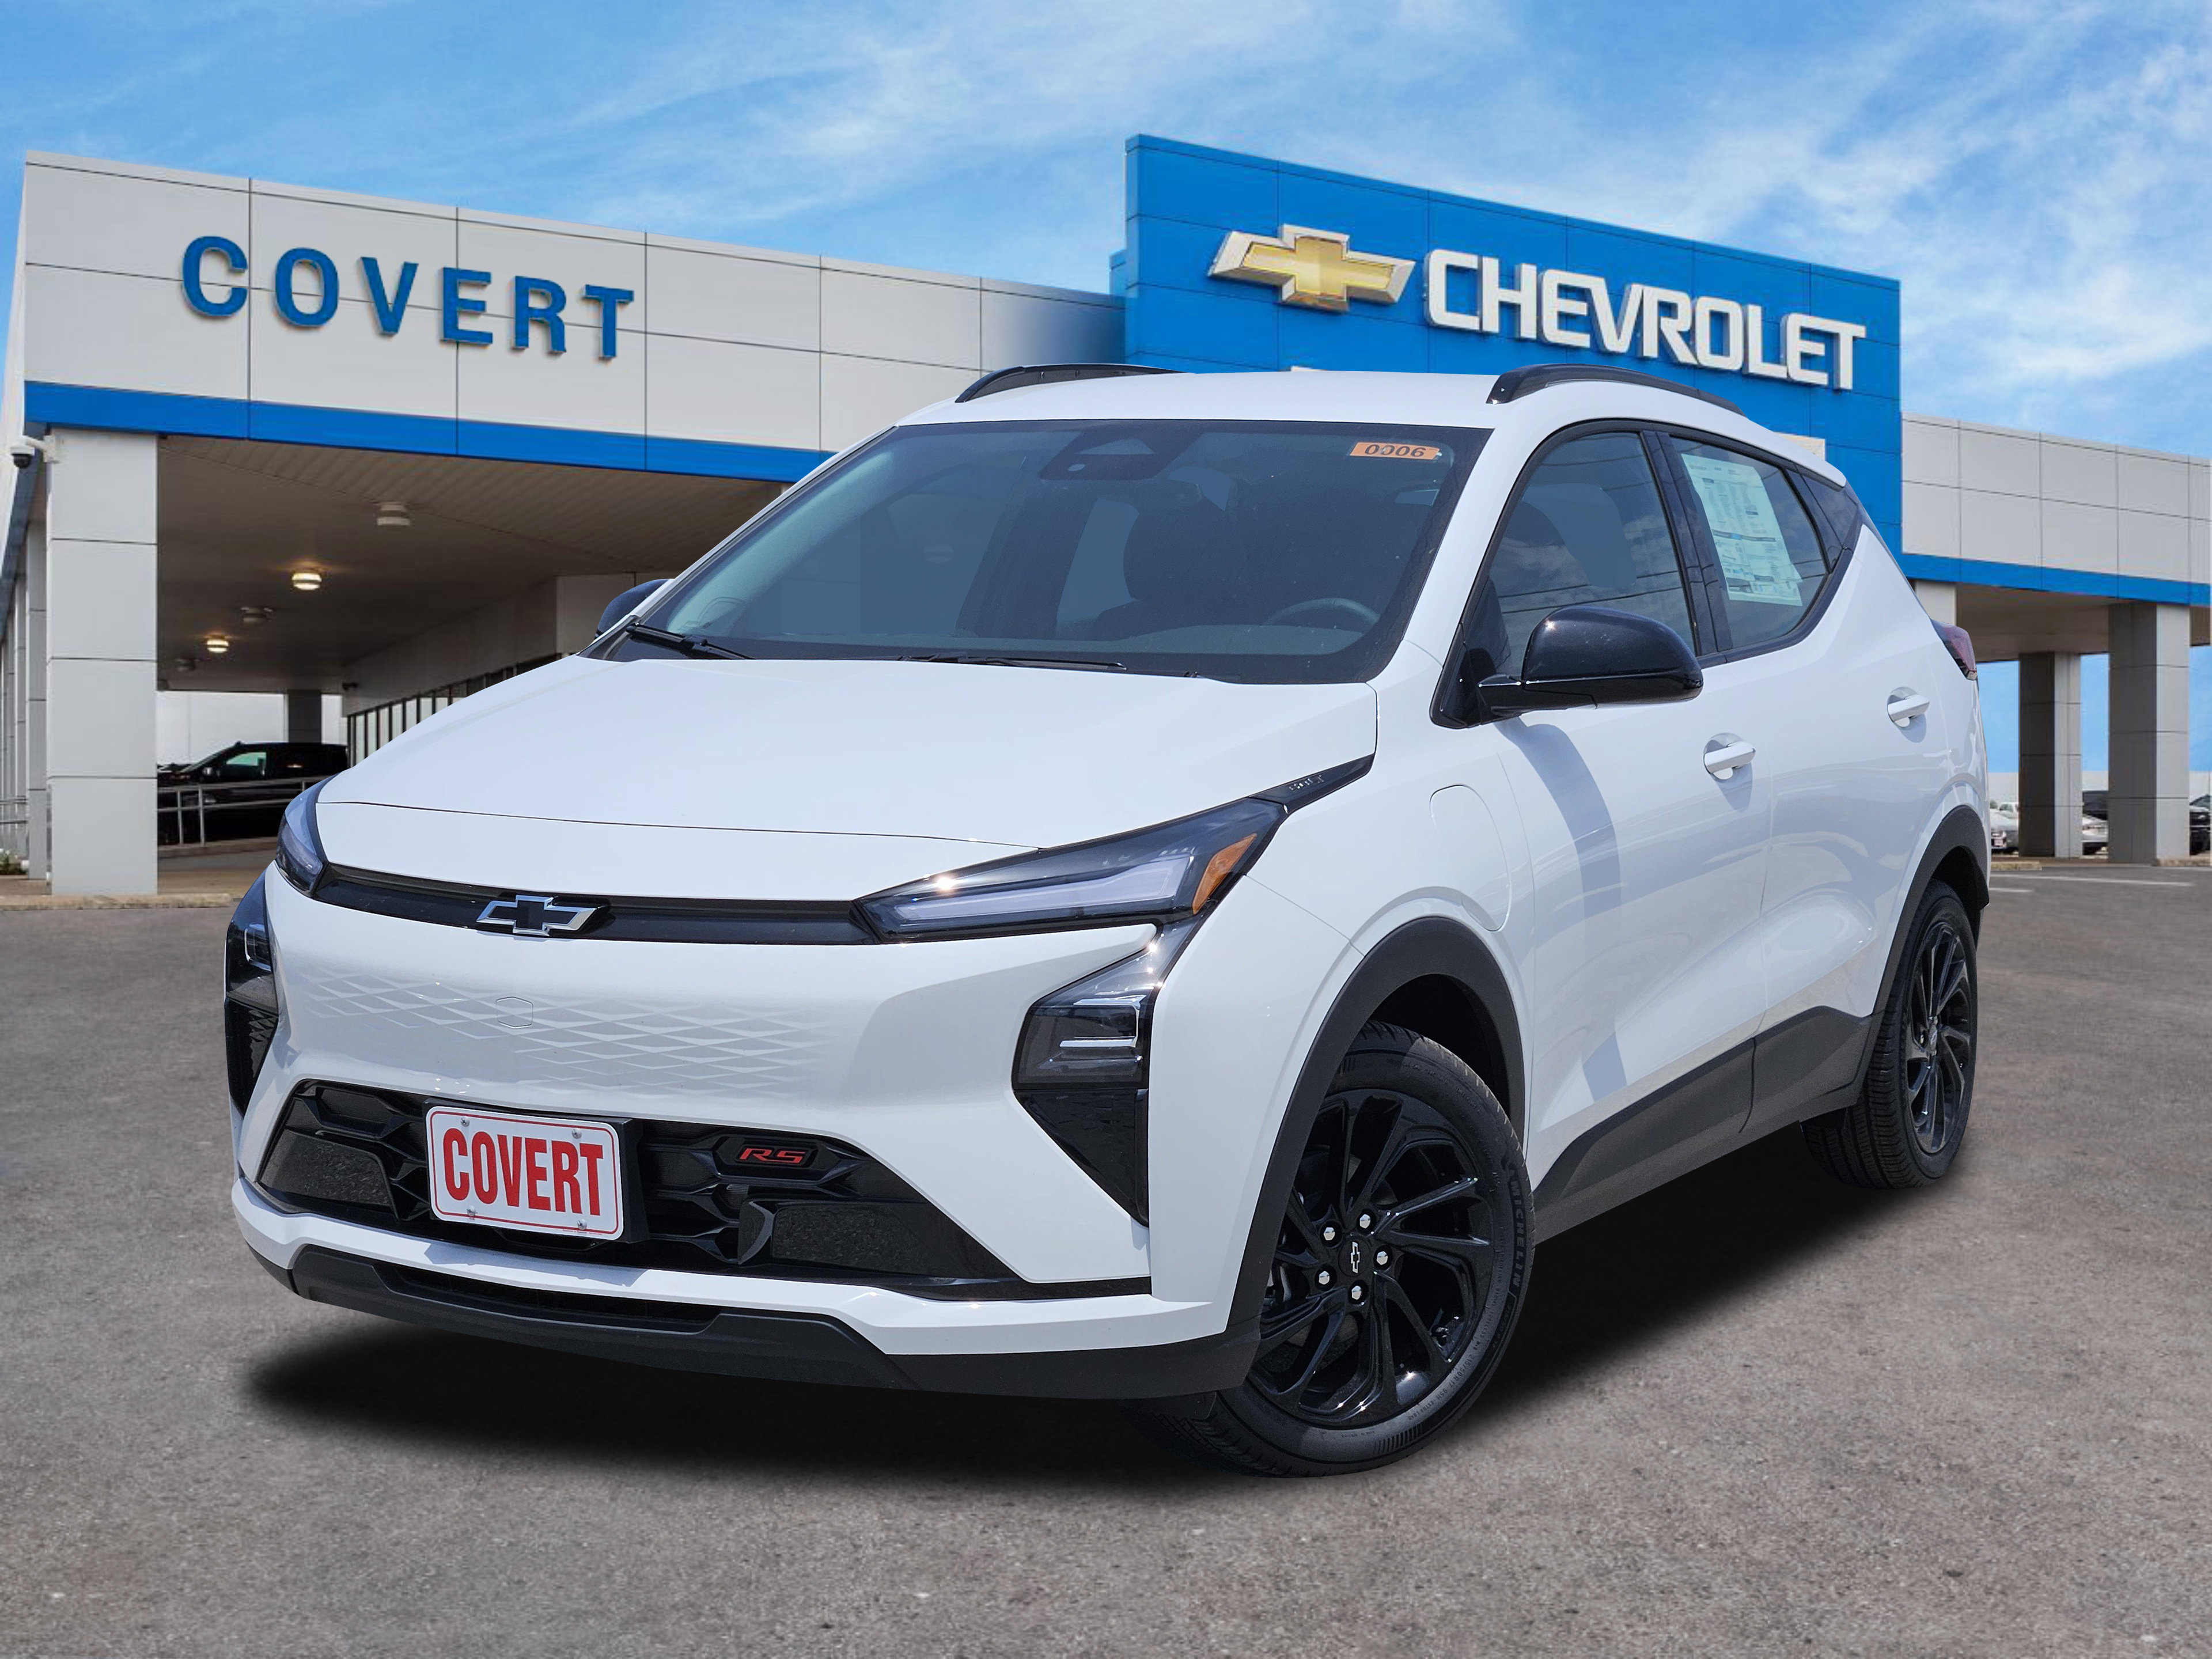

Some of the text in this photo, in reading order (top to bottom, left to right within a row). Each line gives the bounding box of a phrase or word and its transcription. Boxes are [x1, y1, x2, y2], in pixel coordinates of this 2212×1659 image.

[182, 236, 635, 359] COVERT
[1425, 248, 1867, 390] CHEVROLET
[1364, 444, 1426, 457] 0006
[443, 1127, 604, 1216] COVERT
[740, 1147, 806, 1164] RS
[1510, 1181, 1524, 1287] MICHELIN
